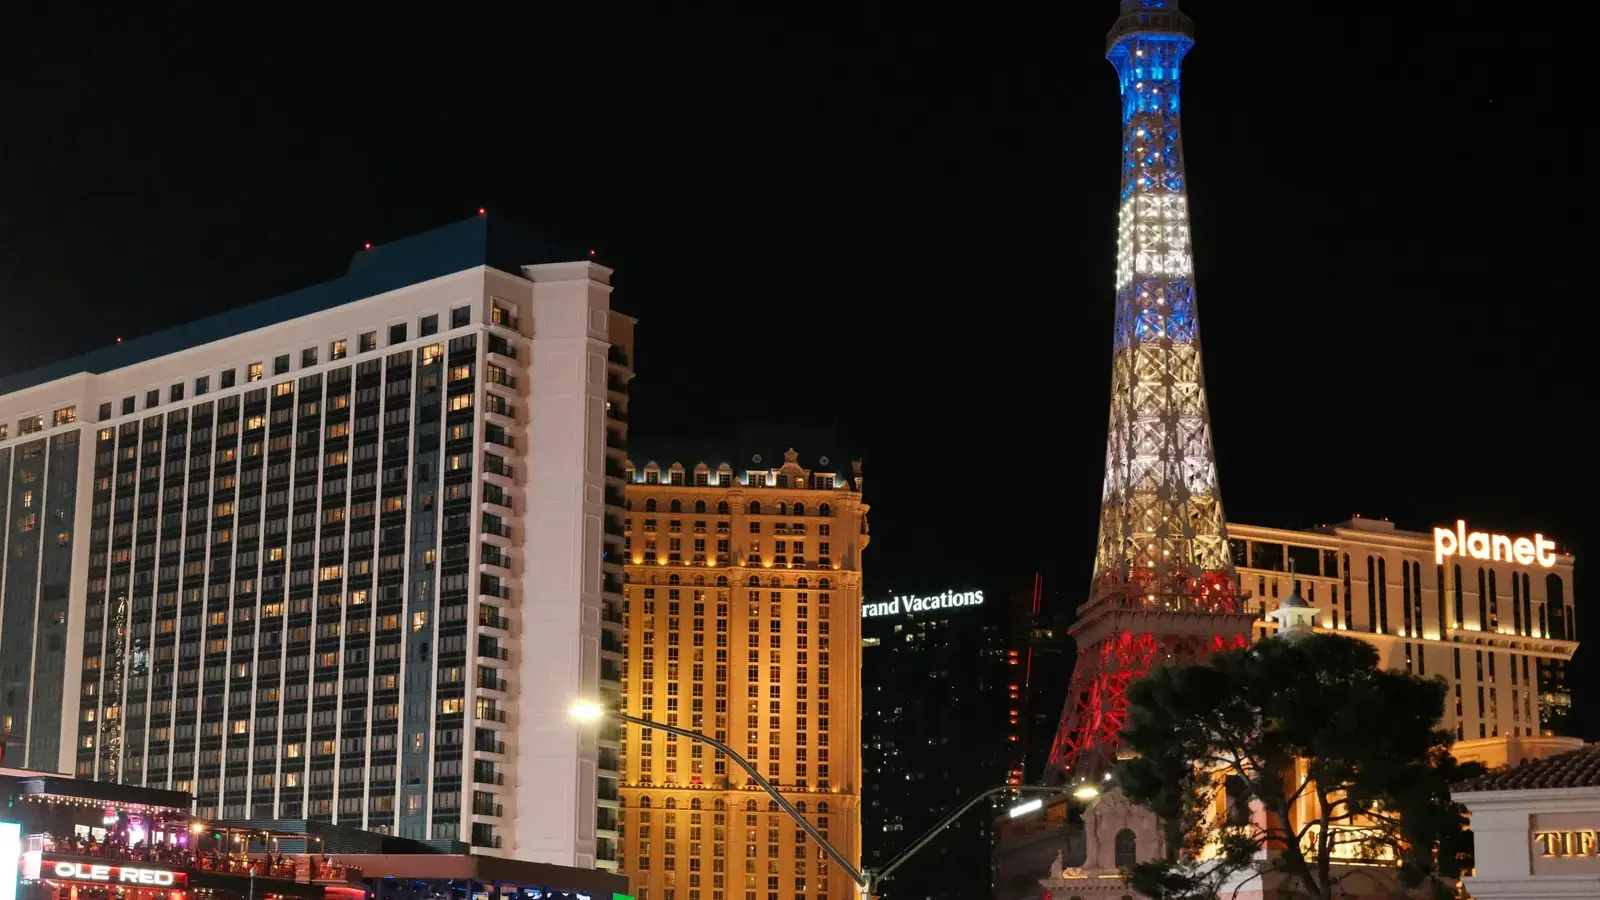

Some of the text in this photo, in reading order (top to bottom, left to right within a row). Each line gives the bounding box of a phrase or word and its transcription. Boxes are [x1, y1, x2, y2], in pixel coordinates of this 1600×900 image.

[1433, 519, 1556, 568] planet
[861, 590, 984, 617] rand Vacations
[1534, 830, 1600, 857] TIF
[55, 862, 174, 886] OLE RED
